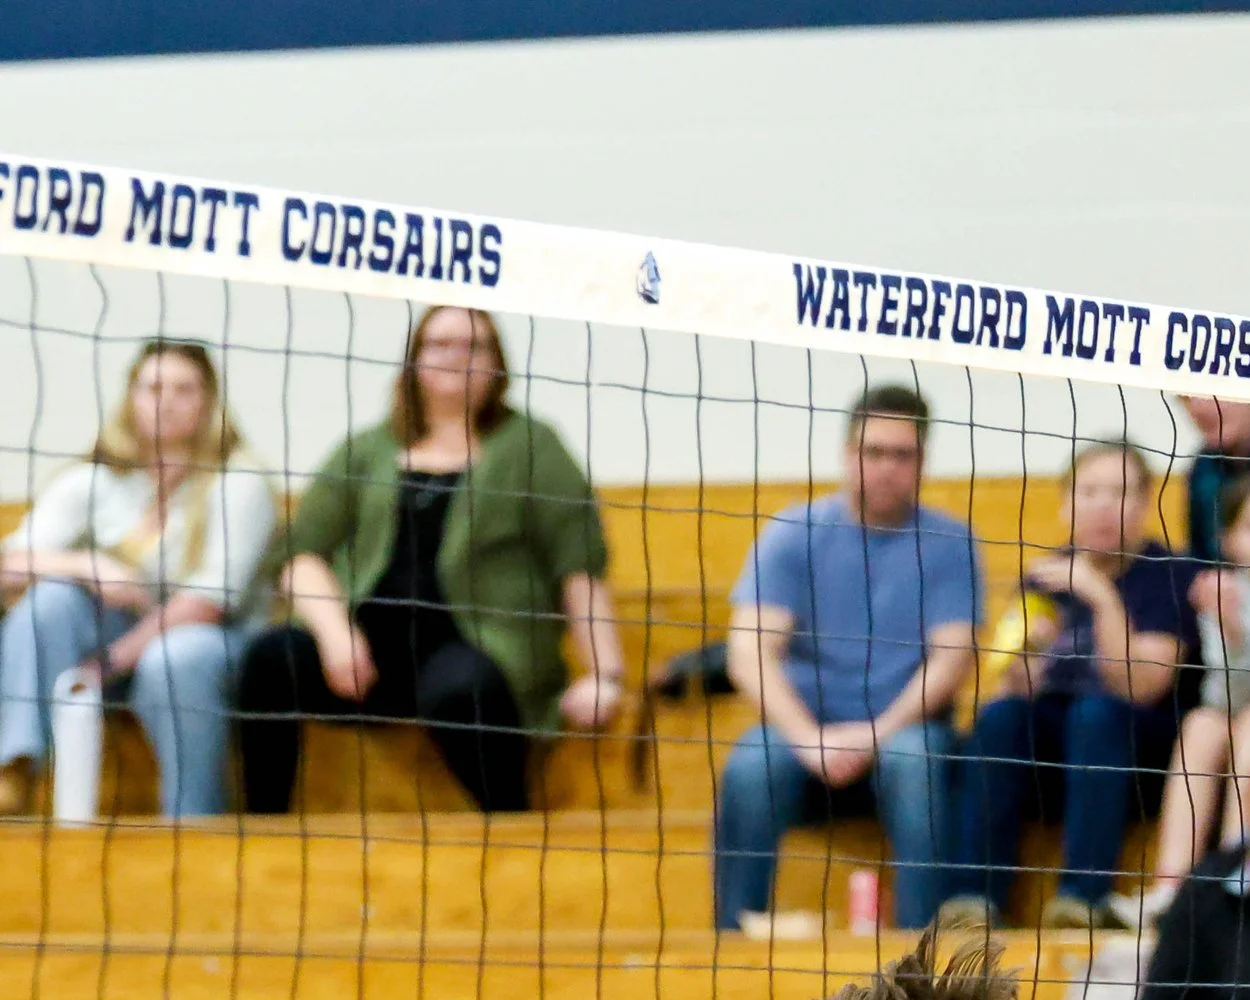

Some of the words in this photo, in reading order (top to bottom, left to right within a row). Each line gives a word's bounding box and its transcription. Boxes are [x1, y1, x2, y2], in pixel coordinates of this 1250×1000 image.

[124, 177, 259, 257] MOTT
[281, 197, 502, 288] CORSAIRS
[792, 263, 1027, 351] WATERFORD
[1043, 295, 1150, 366] MOTT
